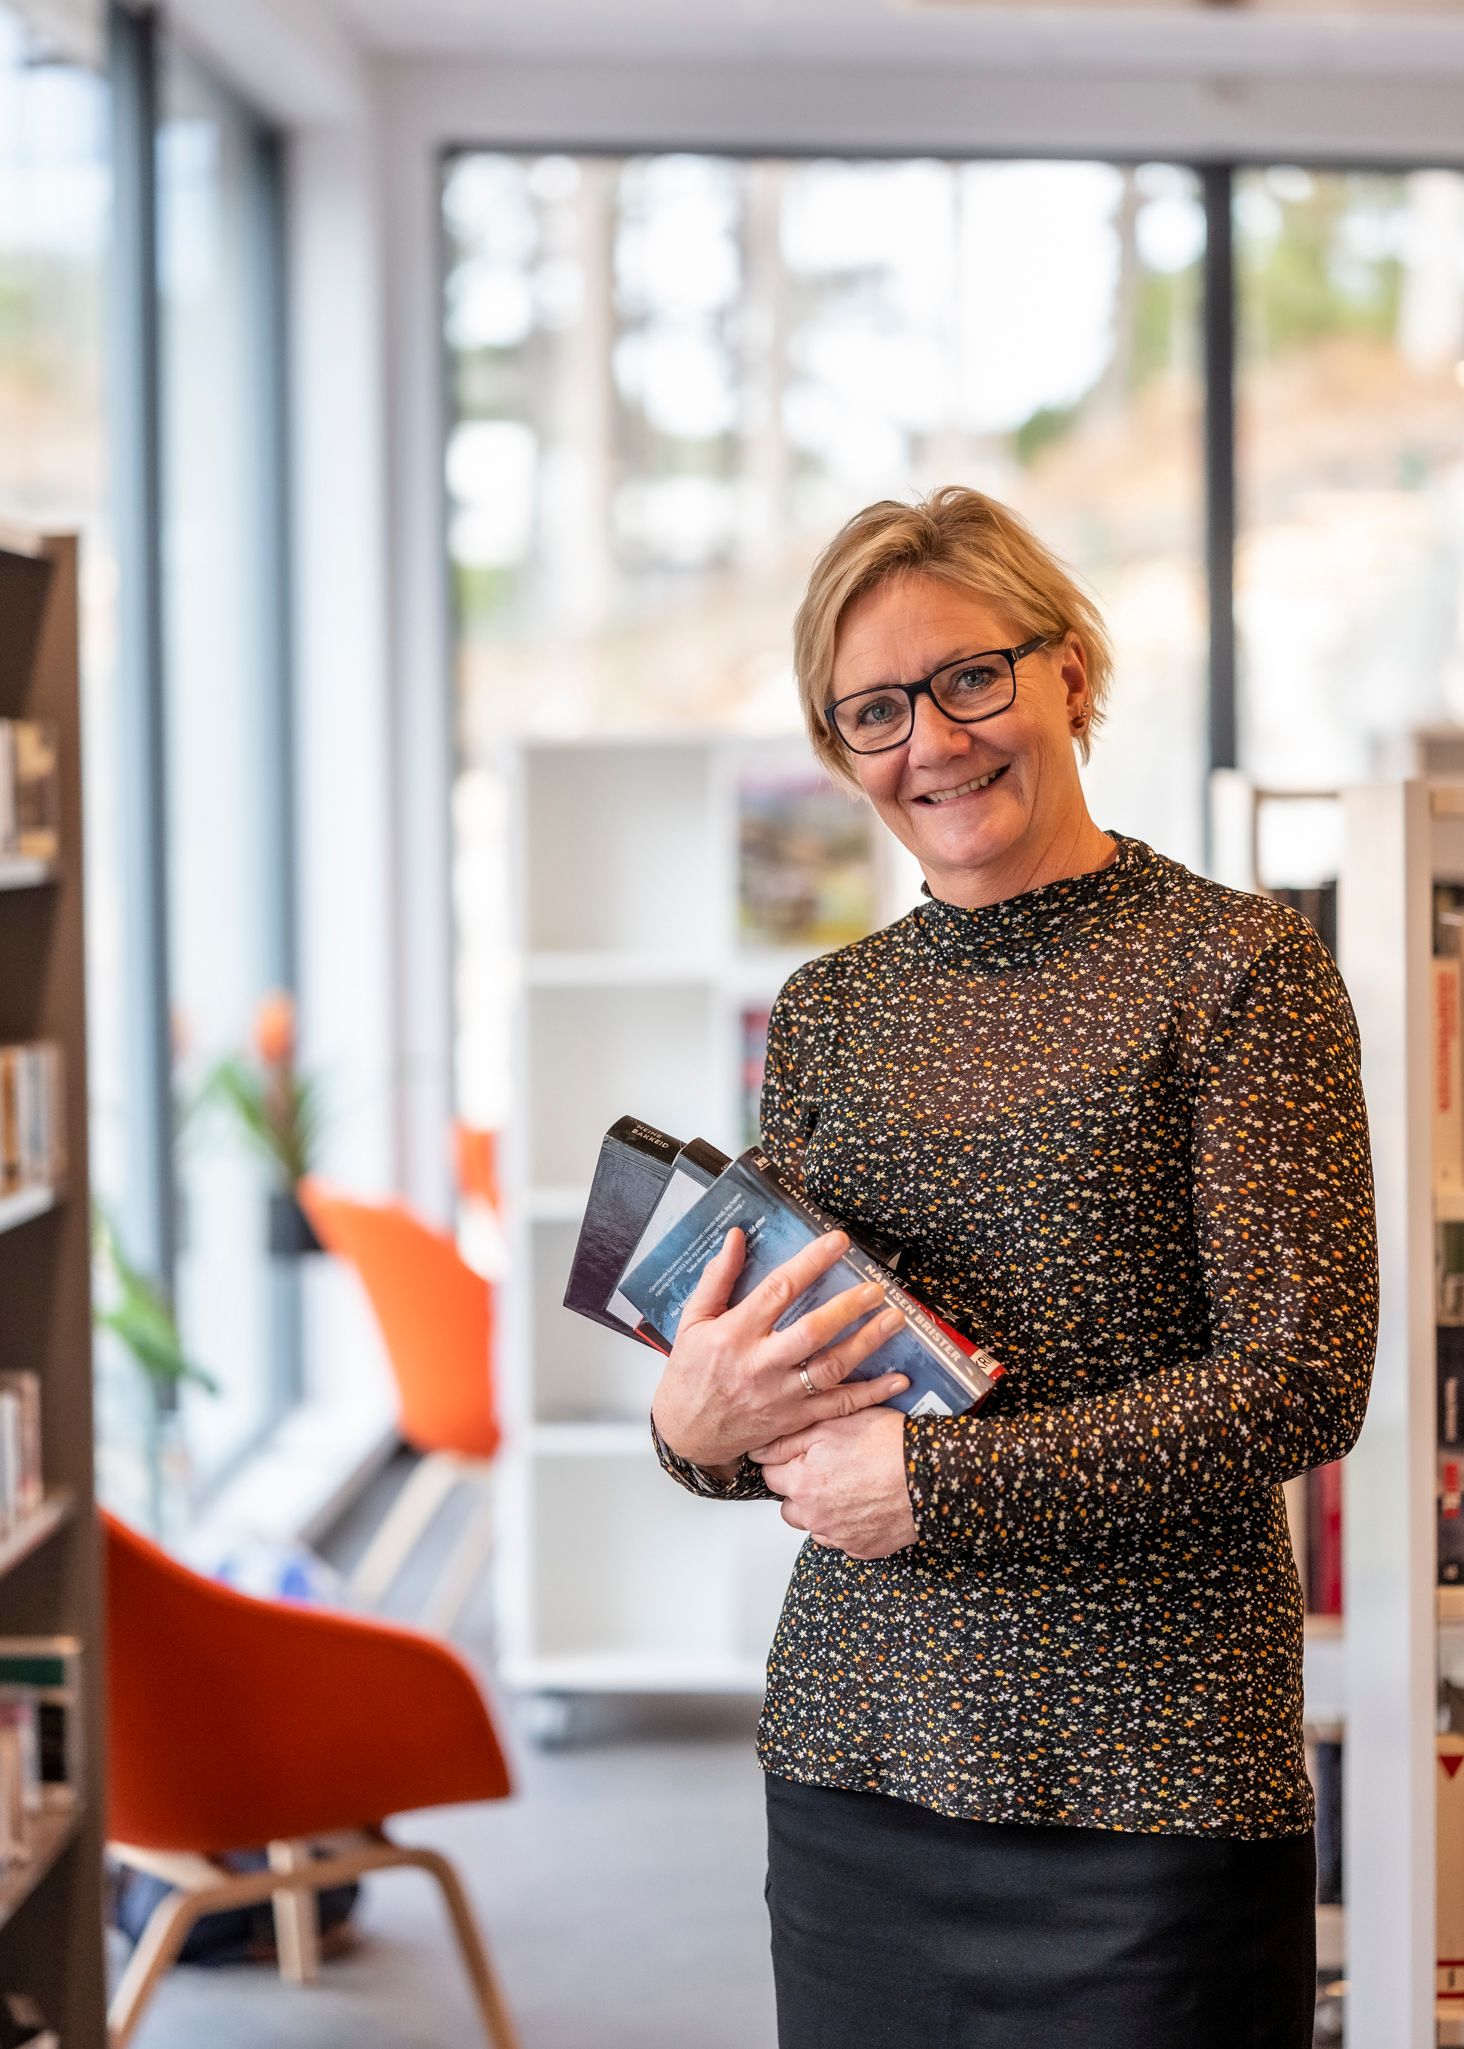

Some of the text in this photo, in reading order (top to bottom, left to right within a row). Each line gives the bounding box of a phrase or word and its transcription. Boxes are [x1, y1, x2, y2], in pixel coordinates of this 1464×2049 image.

[631, 1129, 669, 1148] BAKKEID
[778, 1177, 822, 1222] CAMILLA
[670, 1306, 681, 1318] Hun
[889, 1288, 918, 1315] ISEN
[914, 1311, 963, 1362] BRISTER
